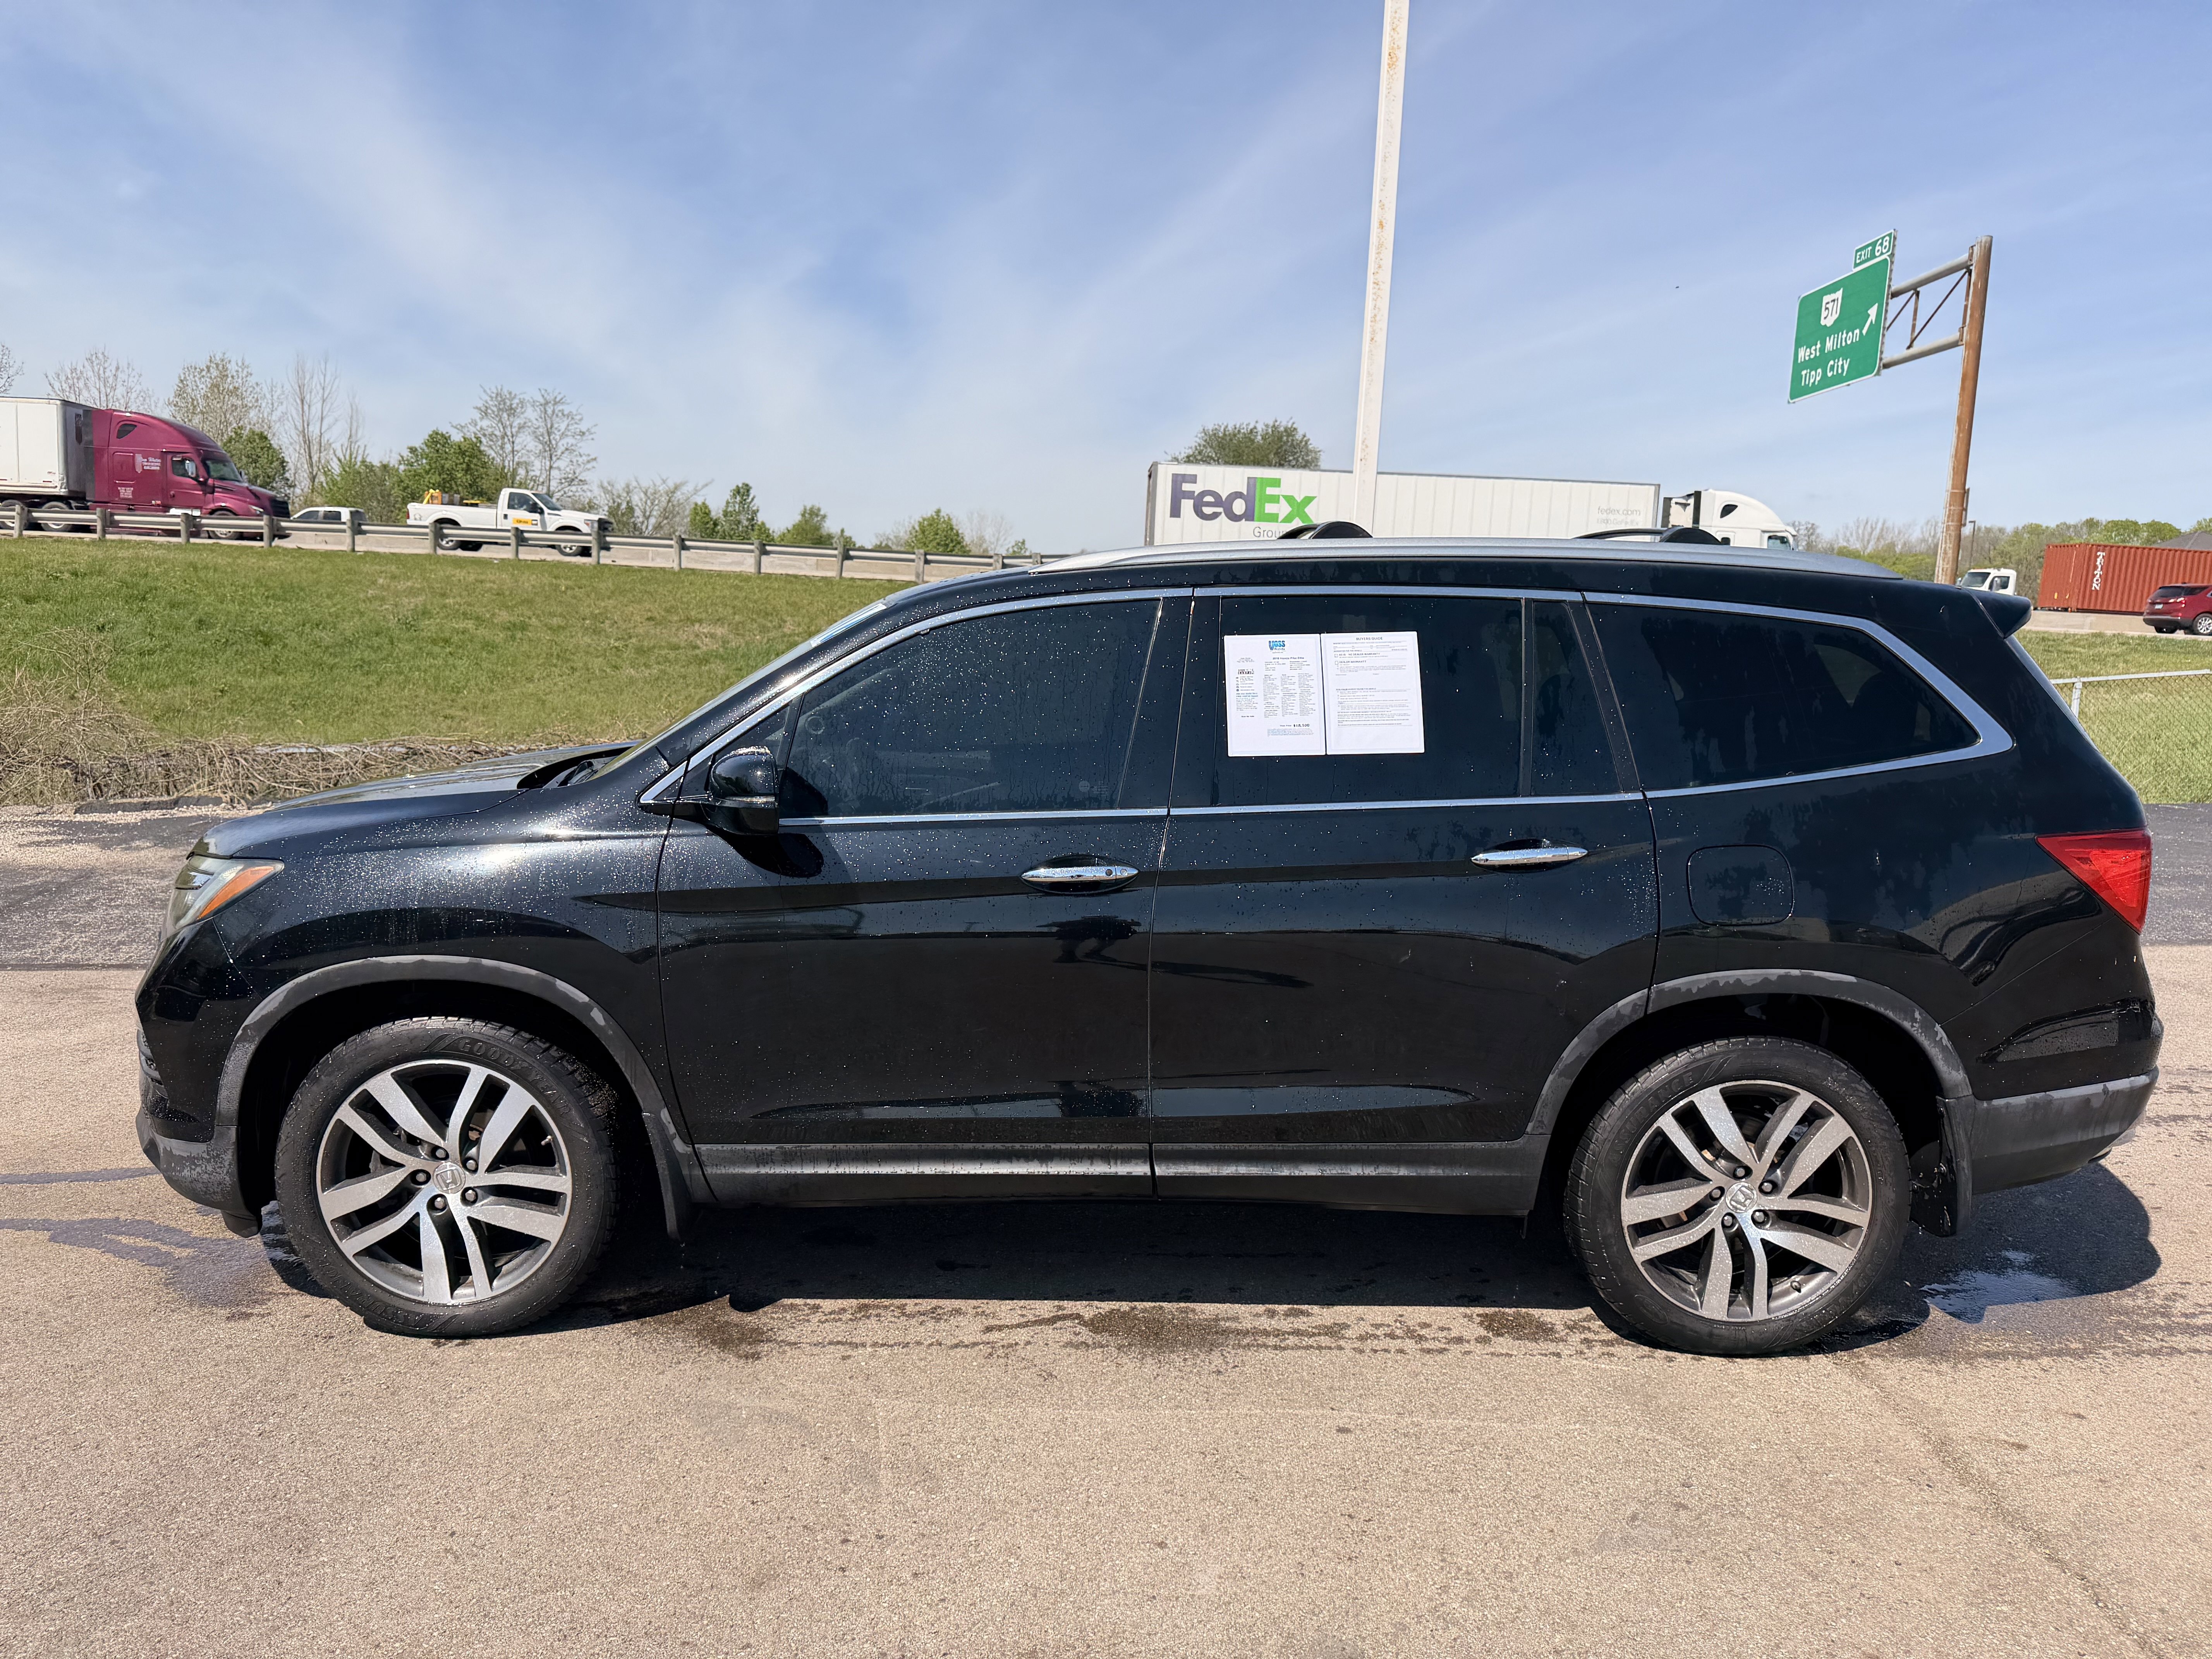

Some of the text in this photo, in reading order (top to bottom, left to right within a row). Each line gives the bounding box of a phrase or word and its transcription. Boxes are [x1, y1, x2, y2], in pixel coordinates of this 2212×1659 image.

[1856, 236, 1889, 263] EXIT 68
[1824, 297, 1839, 319] 571
[1798, 328, 1859, 363] West Milton
[1801, 358, 1850, 387] Tipp City
[1170, 473, 1317, 524] FedEx
[1597, 506, 1641, 517] fedex.com
[2091, 551, 2106, 591] TRITON
[1268, 640, 1285, 651] VOSS
